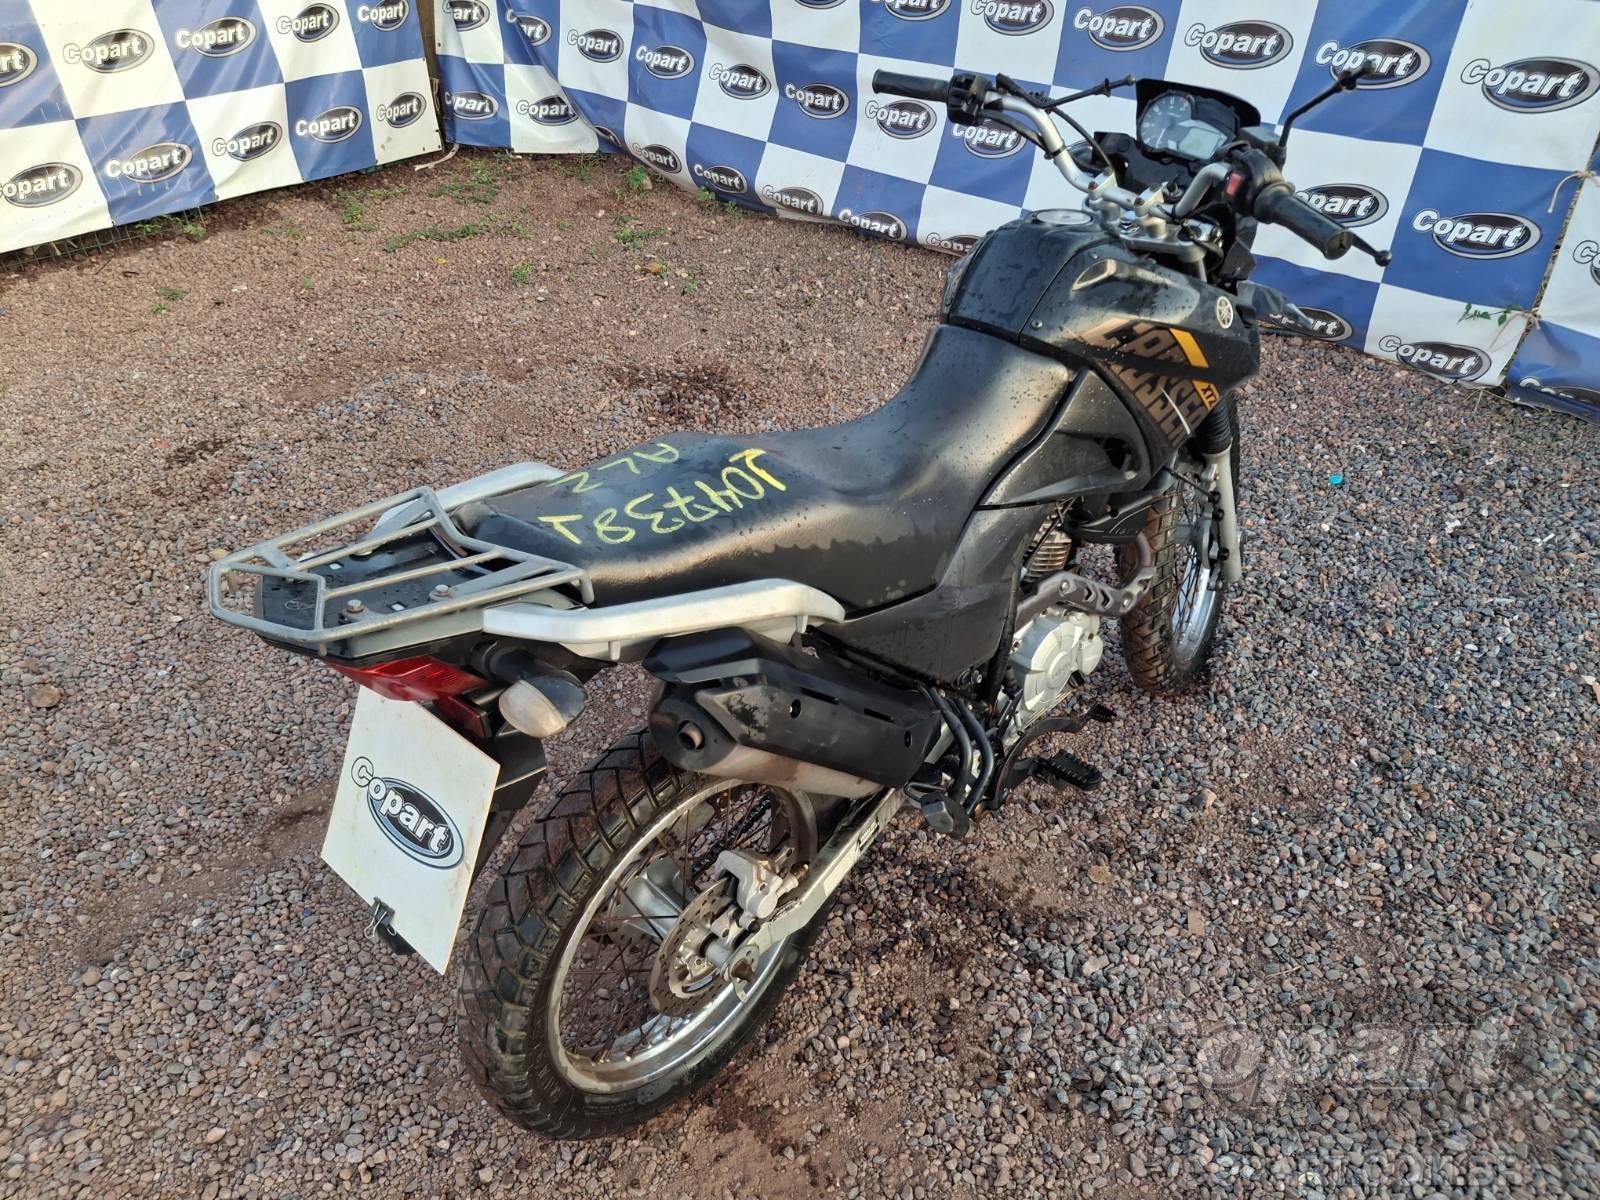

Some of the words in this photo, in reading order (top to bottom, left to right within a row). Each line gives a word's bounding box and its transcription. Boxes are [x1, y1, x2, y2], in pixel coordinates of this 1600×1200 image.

[277, 11, 330, 36] Copart
[358, 2, 404, 24] Copart
[970, 0, 1042, 24] Copart
[1074, 8, 1154, 40] Copart
[63, 36, 142, 66] Copart
[176, 23, 245, 52] Copart
[567, 29, 619, 55] Copart
[1184, 23, 1281, 57] Copart
[636, 45, 686, 72] Copart
[709, 63, 764, 92] Copart
[1460, 58, 1584, 98] Copart
[376, 96, 419, 121] Copart
[785, 83, 840, 111] Copart
[295, 109, 356, 139] Copart
[865, 100, 926, 130] Copart
[212, 126, 274, 157] Copart
[953, 122, 1018, 148] Copart
[105, 145, 182, 181] Copart
[632, 143, 675, 169] Copart
[0, 169, 71, 200] opart
[694, 163, 740, 190] Copart
[1412, 208, 1525, 249] Copart
[1379, 335, 1480, 377] Copart
[351, 756, 451, 855] Copart
